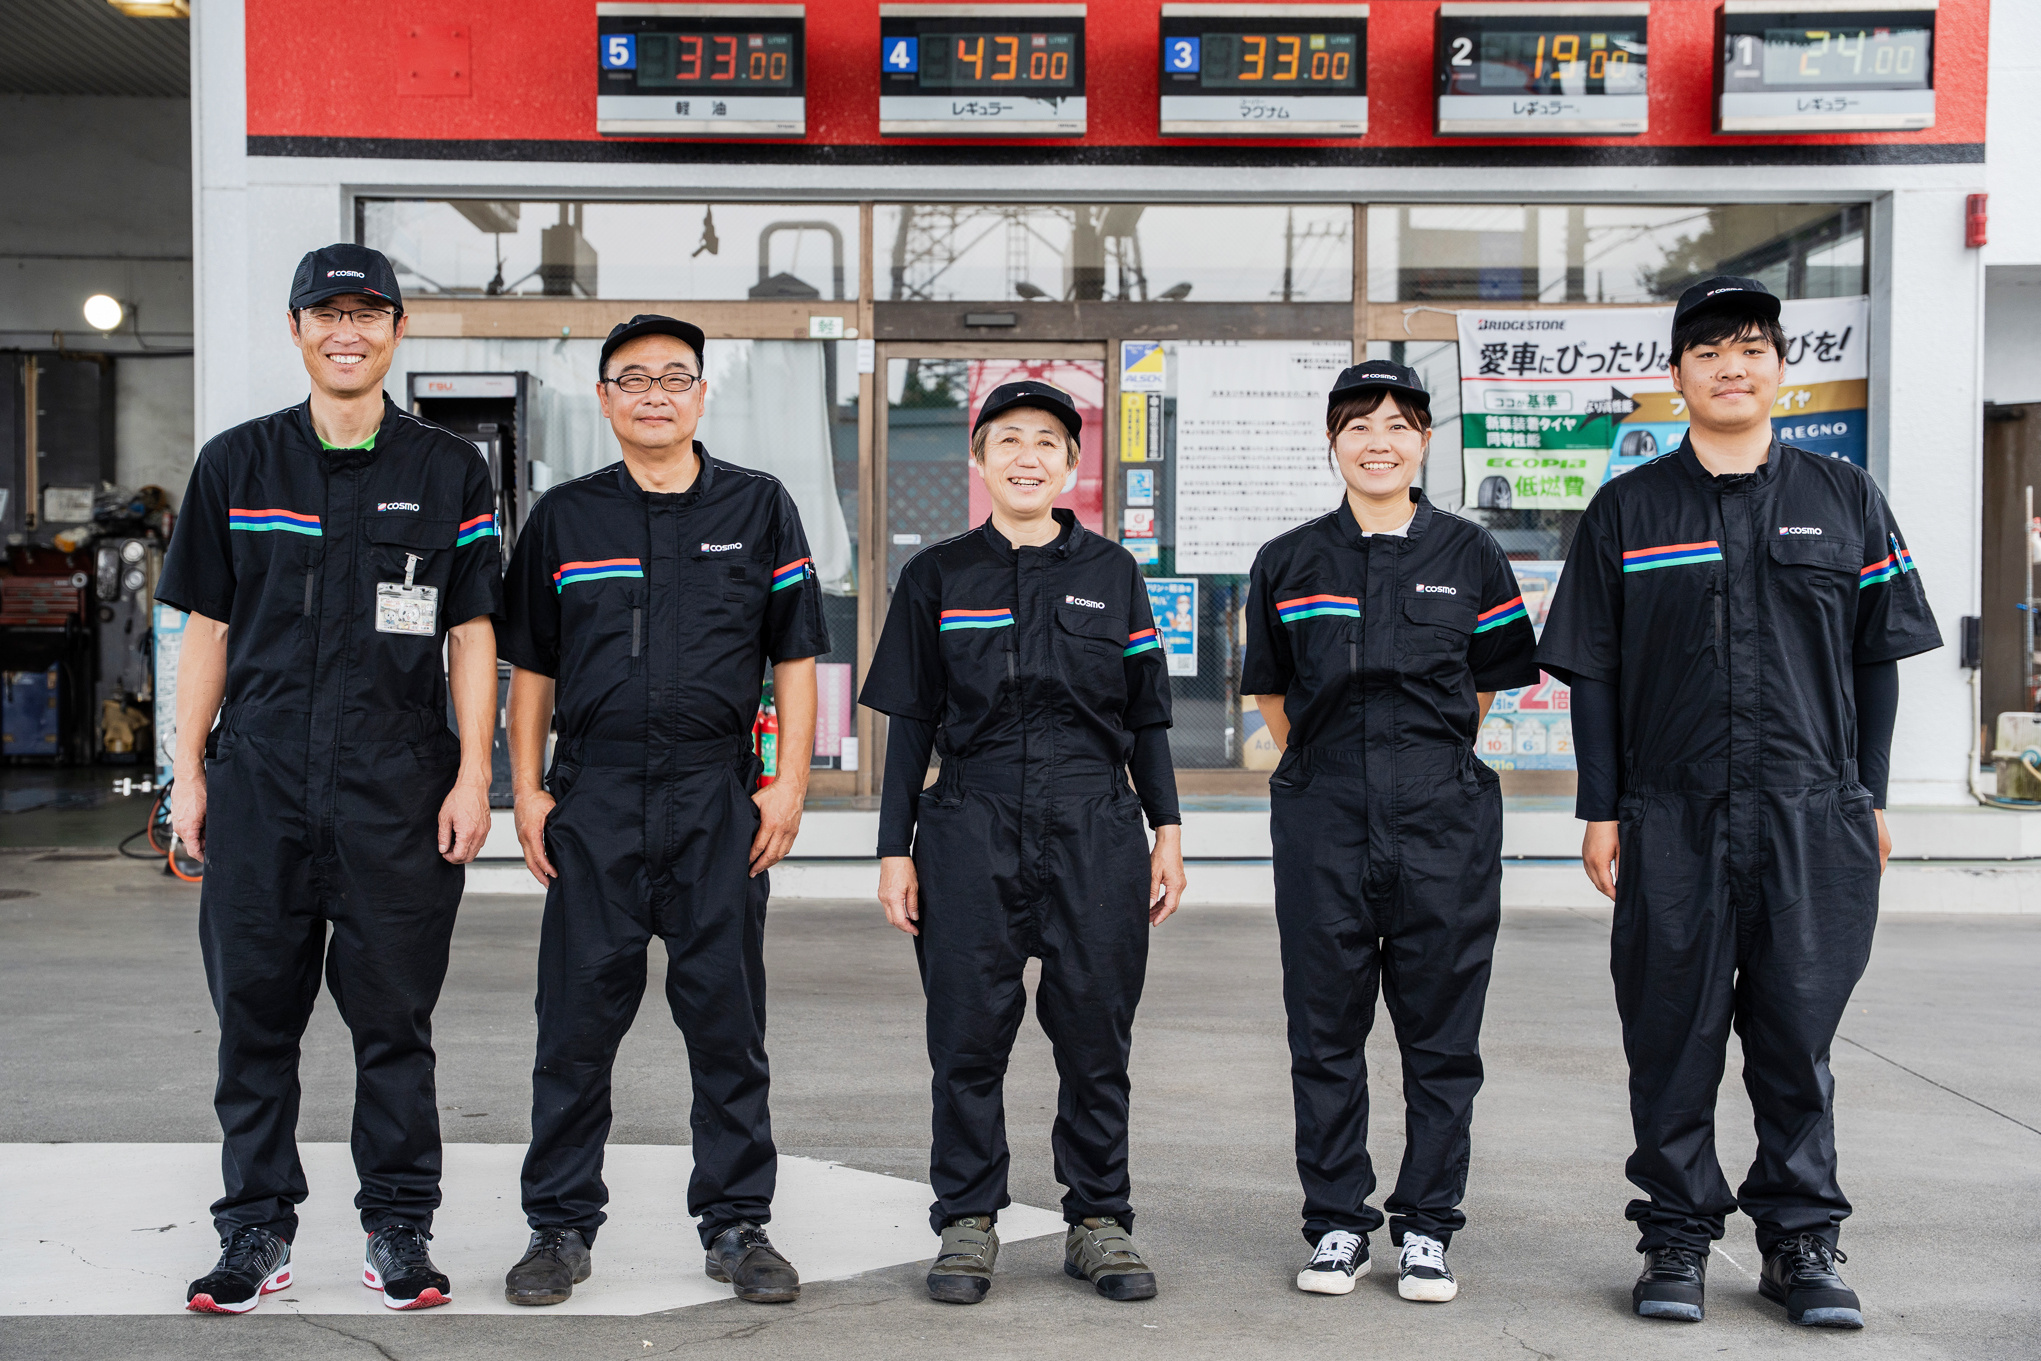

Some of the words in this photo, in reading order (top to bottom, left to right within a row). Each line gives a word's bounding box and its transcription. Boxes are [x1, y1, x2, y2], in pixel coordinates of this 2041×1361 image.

[609, 37, 629, 66] 5
[889, 41, 910, 69] 4
[1173, 41, 1193, 69] 3
[1451, 37, 1473, 66] 2
[1737, 36, 1753, 66] 1
[952, 102, 1014, 115] レギュラー
[1240, 106, 1290, 119] マグナム
[1513, 101, 1574, 115] レギュラー
[335, 270, 365, 279] COSMO
[1479, 320, 1566, 331] BRIDGESTONE
[1369, 373, 1398, 381] COSMO
[1485, 415, 1577, 432] 新車装着タイヤ
[1780, 421, 1848, 440] REGNO
[1486, 431, 1541, 447] 同等性能
[1515, 475, 1584, 497] 低燃費
[387, 502, 420, 512] COSMO
[1789, 527, 1823, 536] COSMO
[709, 541, 743, 552] COSMO
[1424, 585, 1457, 596] COSMO
[1074, 597, 1106, 610] COSMO
[1487, 740, 1502, 752] 10
[1522, 740, 1534, 752] 6
[1557, 740, 1568, 752] 2
